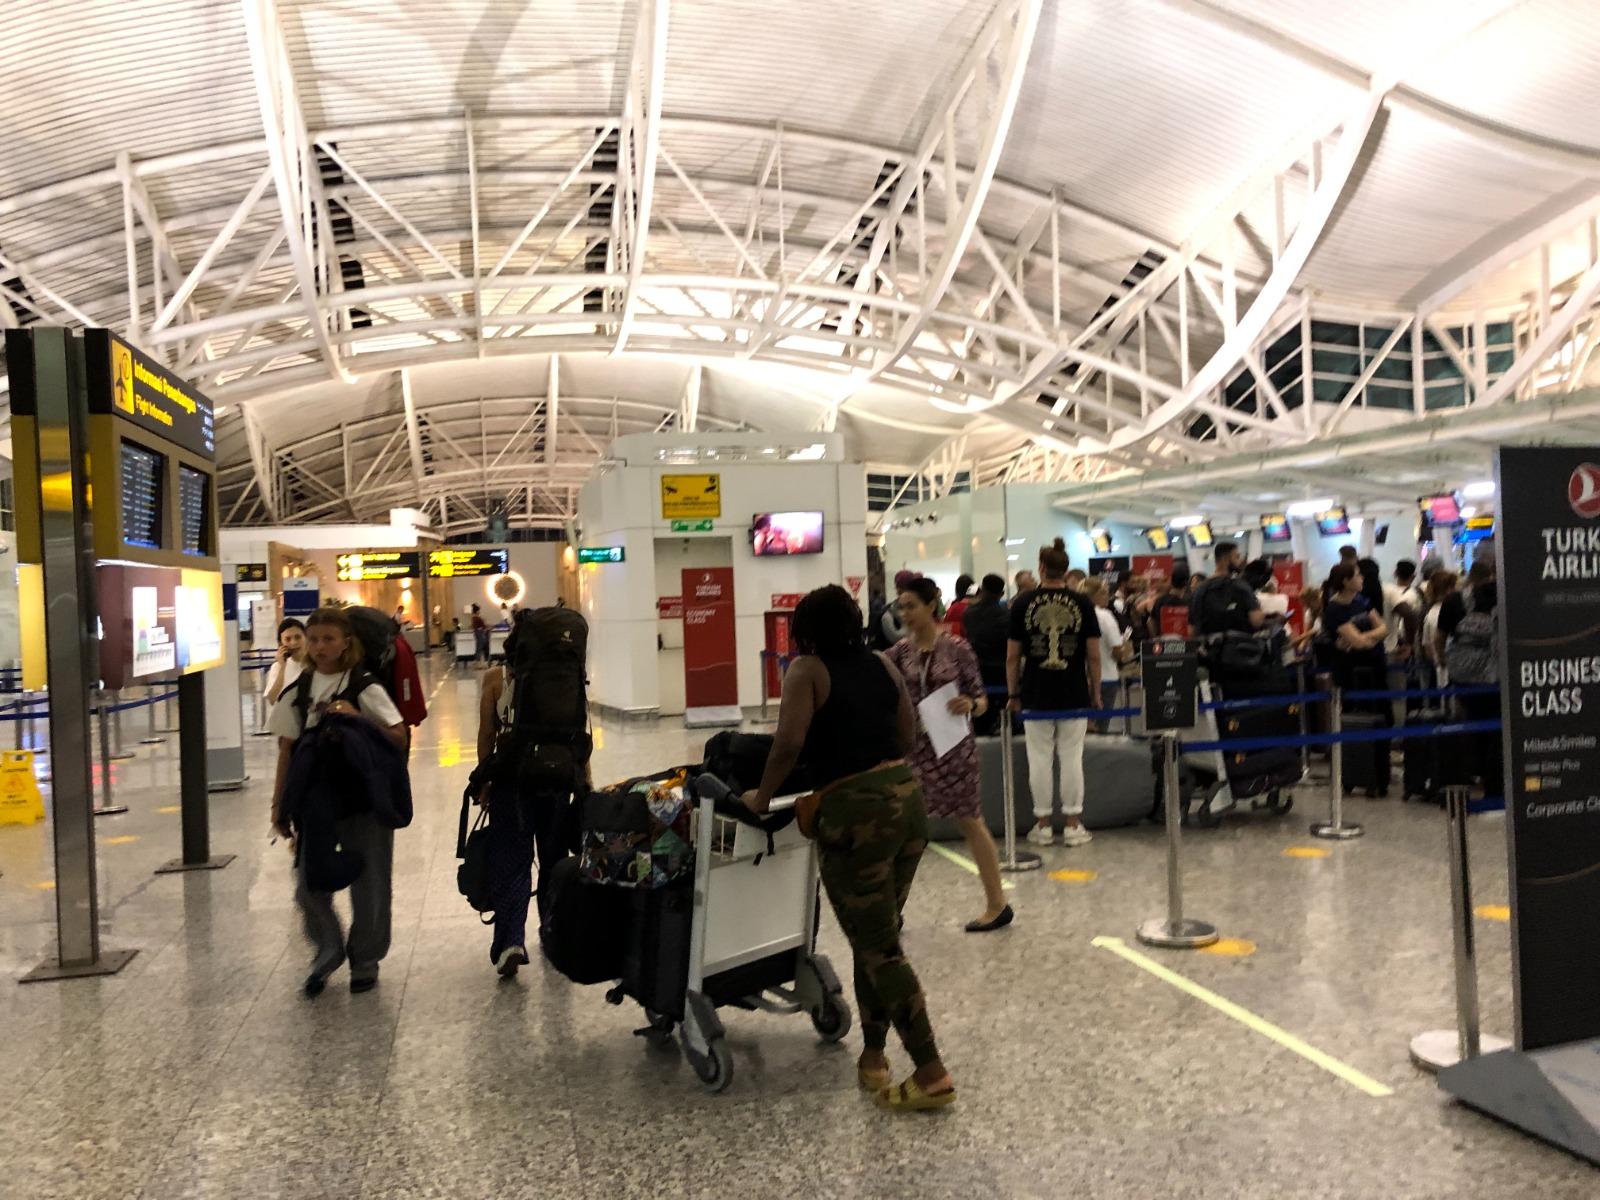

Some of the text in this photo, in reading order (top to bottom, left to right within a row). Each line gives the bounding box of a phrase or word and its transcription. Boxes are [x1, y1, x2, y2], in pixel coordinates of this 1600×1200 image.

[1541, 553, 1600, 580] AIRLI
[1521, 686, 1583, 719] CLASS
[1526, 799, 1585, 819] Corporate
